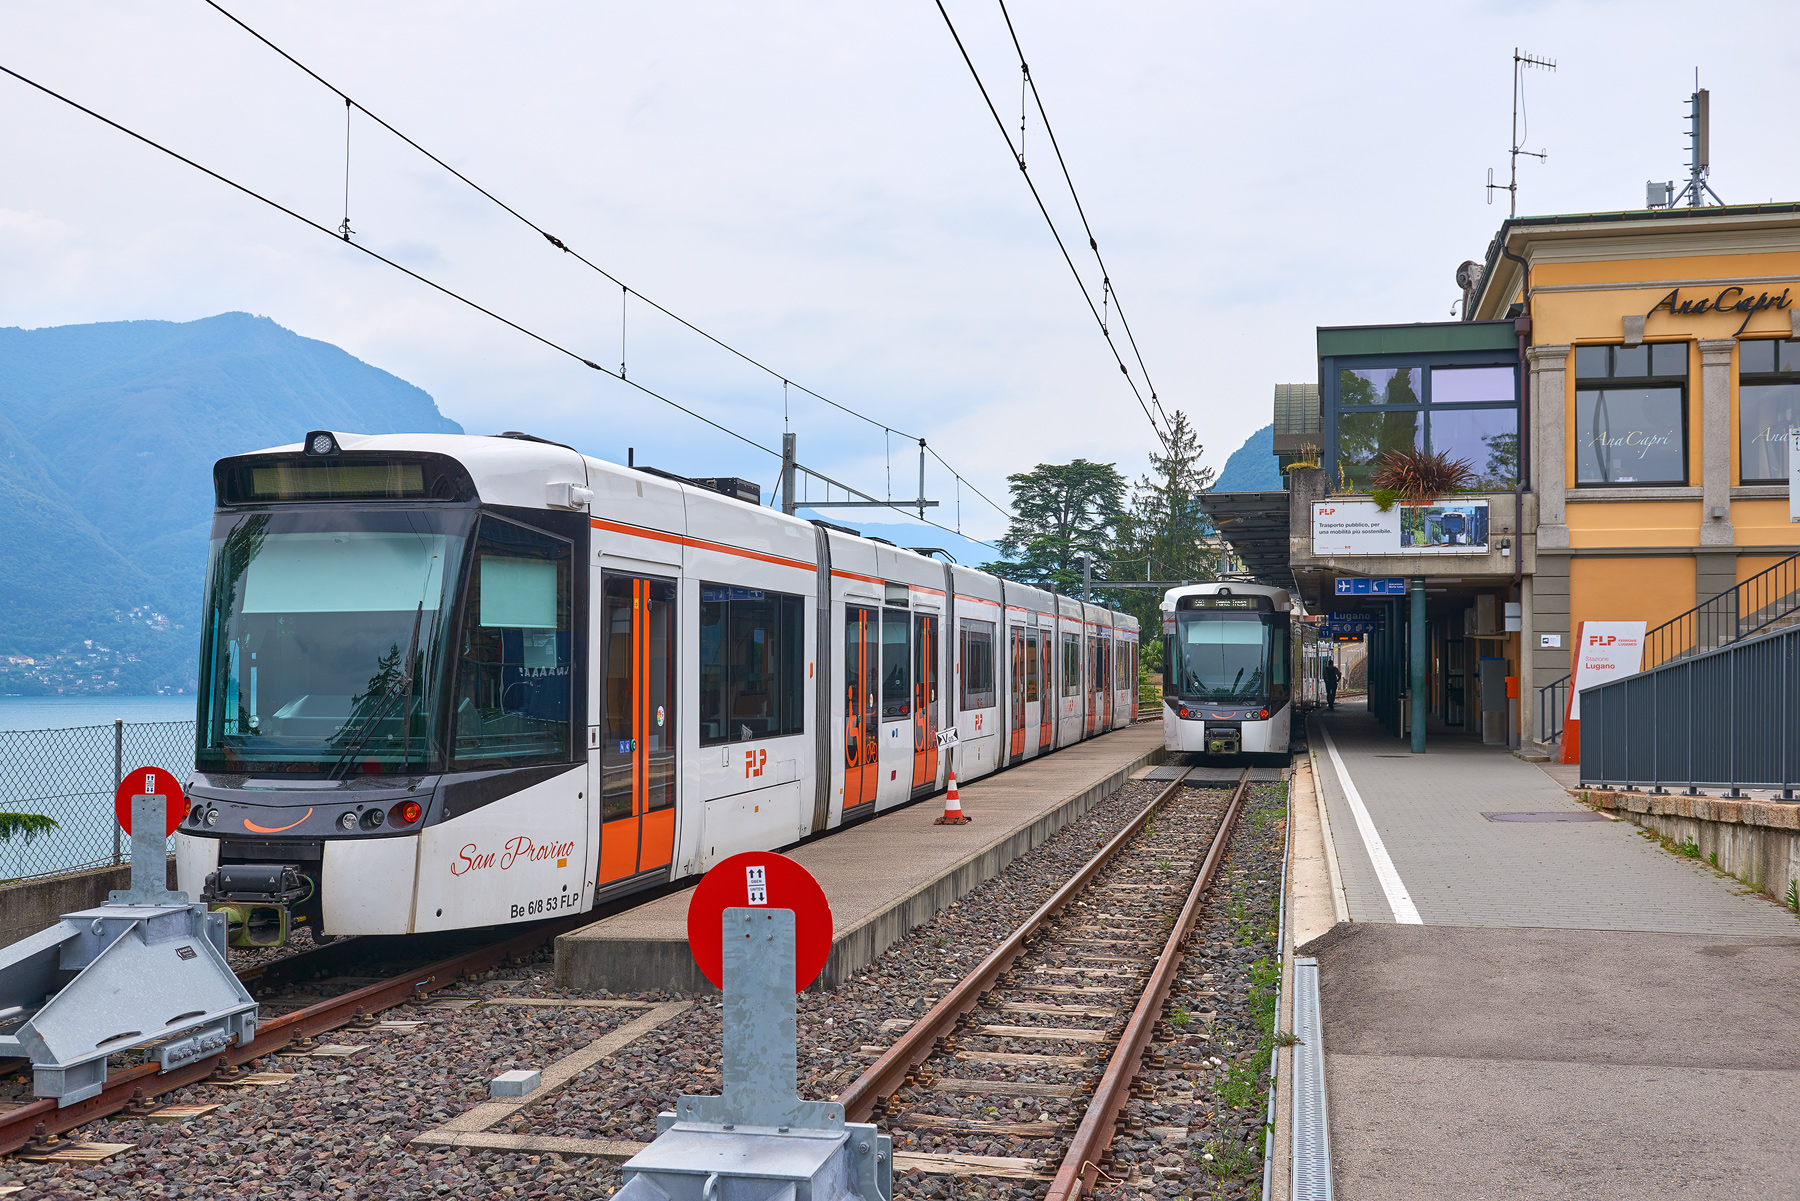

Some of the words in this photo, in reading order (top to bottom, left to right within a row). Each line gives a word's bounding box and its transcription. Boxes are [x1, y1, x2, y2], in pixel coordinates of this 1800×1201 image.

[1319, 508, 1336, 516] FLP
[1333, 611, 1371, 621] Lugano
[1589, 635, 1617, 646] FLP
[746, 748, 767, 778] FLP
[450, 843, 496, 877] San
[500, 836, 575, 870] Provino
[510, 904, 525, 918] Be
[528, 899, 543, 915] 6/8
[546, 896, 558, 912] 53
[560, 892, 579, 908] FLP
